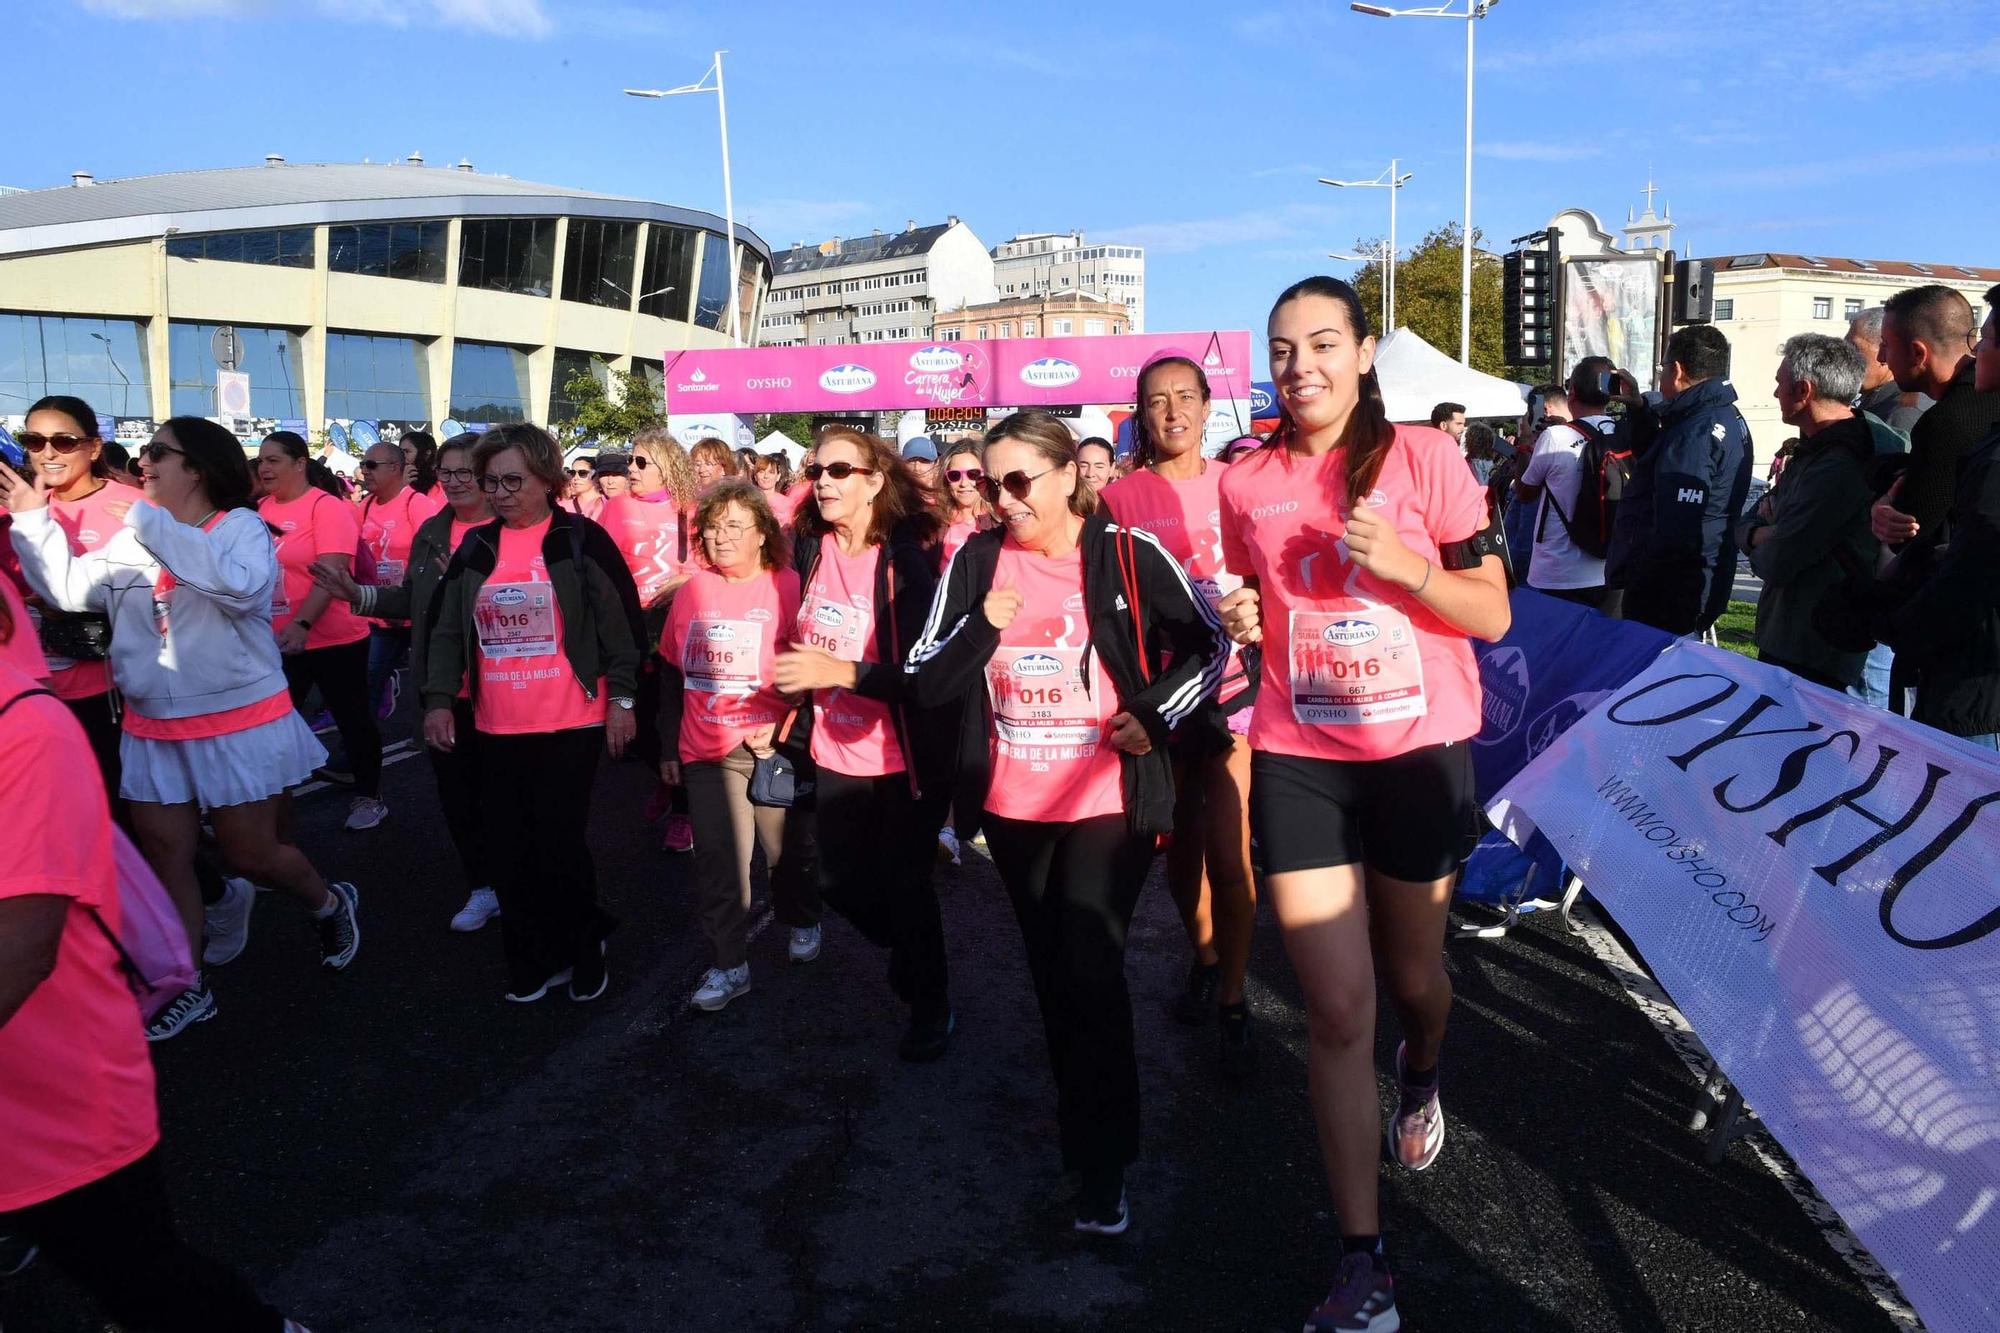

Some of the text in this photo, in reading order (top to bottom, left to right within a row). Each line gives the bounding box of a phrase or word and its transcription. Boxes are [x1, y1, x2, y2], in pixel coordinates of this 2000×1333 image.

[914, 355, 960, 367] ASTURIANA
[823, 375, 873, 387] ASTURIANA
[904, 370, 950, 385] Carrera
[1025, 371, 1076, 382] ASTURIANA
[677, 382, 721, 393] Santander
[746, 377, 793, 390] OYSHO
[931, 382, 967, 405] Mujer
[926, 421, 983, 432] OYSHO
[1677, 487, 1704, 504] HH
[1251, 500, 1299, 520] OYSHO
[1140, 517, 1180, 530] OYSHO
[500, 613, 529, 628] 016
[1327, 629, 1376, 641] ASTURIANA
[809, 632, 838, 652] 016
[707, 650, 734, 663] 016
[522, 669, 532, 680] LA
[533, 667, 561, 680] MUJER
[1016, 662, 1060, 672] ASTURIANA
[1332, 658, 1381, 680] 016
[1019, 688, 1063, 705] 016
[1348, 685, 1366, 695] 667
[1031, 710, 1052, 718] 3183
[1307, 708, 1347, 718] OYSHO
[1373, 704, 1411, 716] Santander
[1029, 747, 1042, 760] DE
[1044, 747, 1058, 760] LA
[1060, 744, 1096, 760] MUJER
[1597, 774, 1777, 943] WWW.OYSHO.COM
